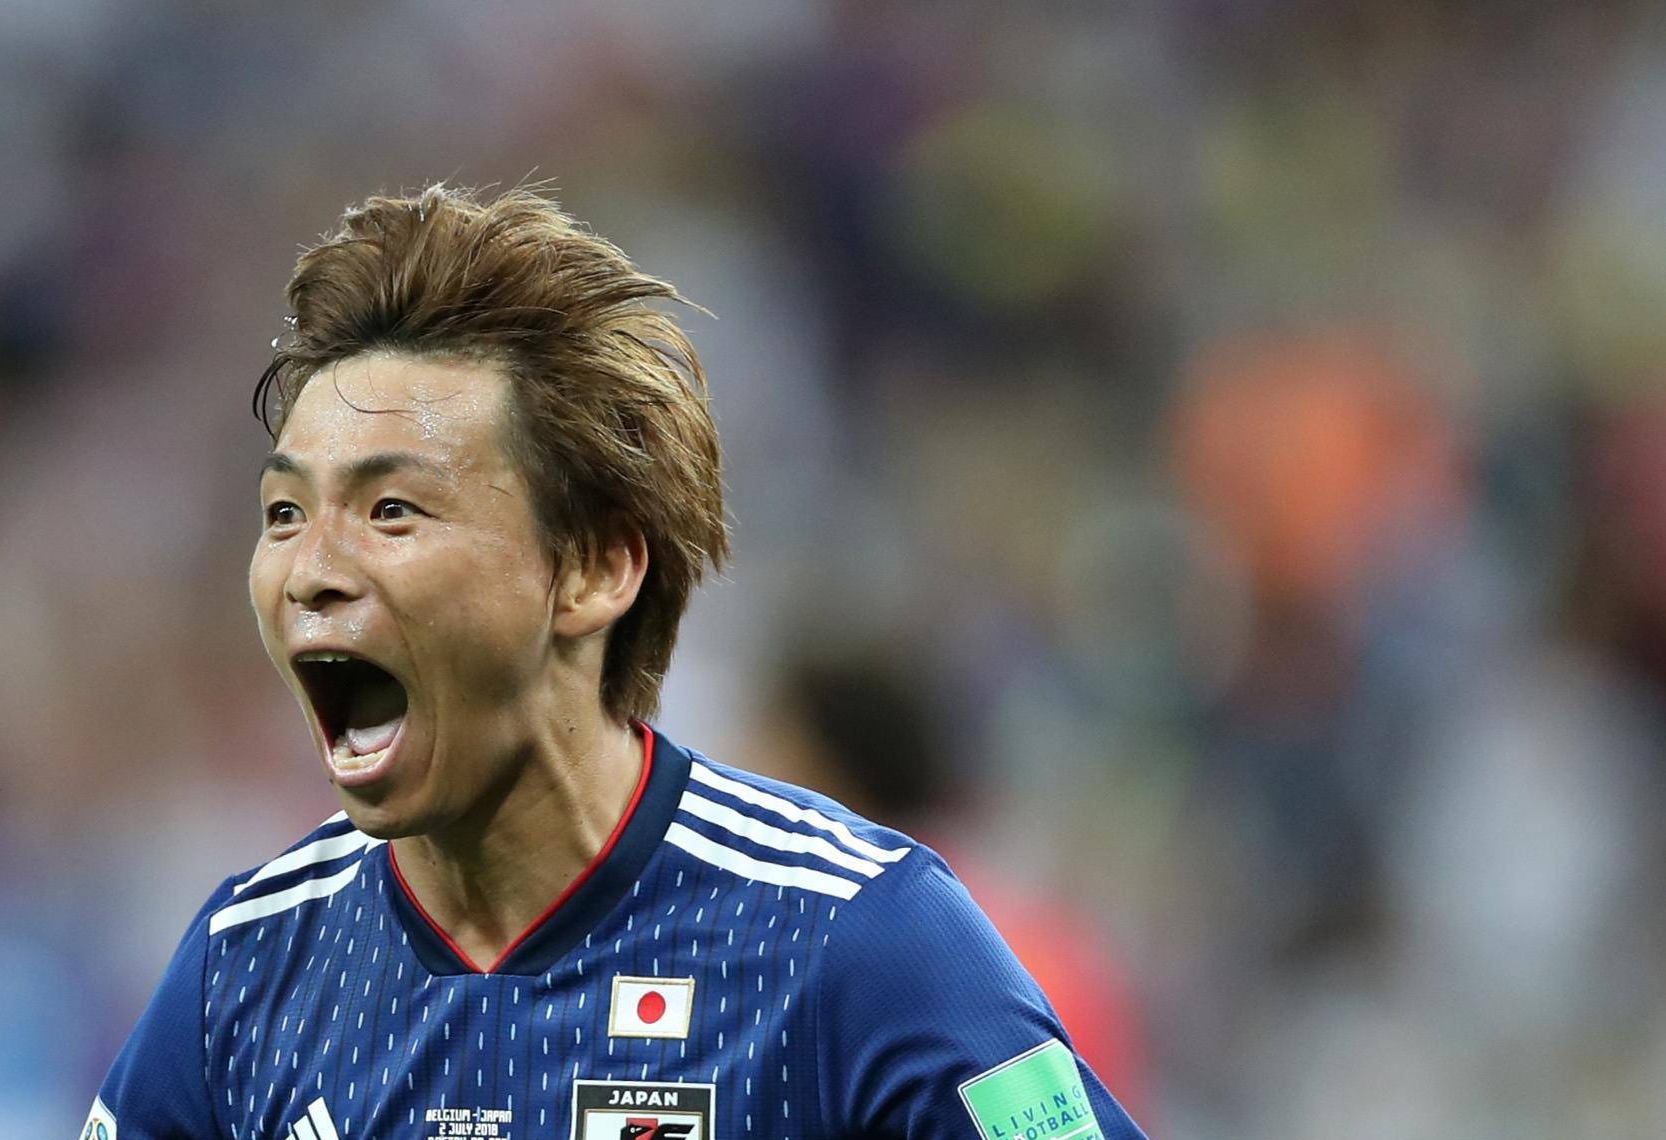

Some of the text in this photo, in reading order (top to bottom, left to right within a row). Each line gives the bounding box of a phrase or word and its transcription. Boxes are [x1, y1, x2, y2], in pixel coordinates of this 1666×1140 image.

[608, 1090, 679, 1106] JAPAN
[425, 1109, 471, 1122] BELGIUM
[480, 1110, 513, 1123] JAPAN
[992, 1085, 1082, 1138] LIVING
[439, 1123, 498, 1136] 2 JULY 2018
